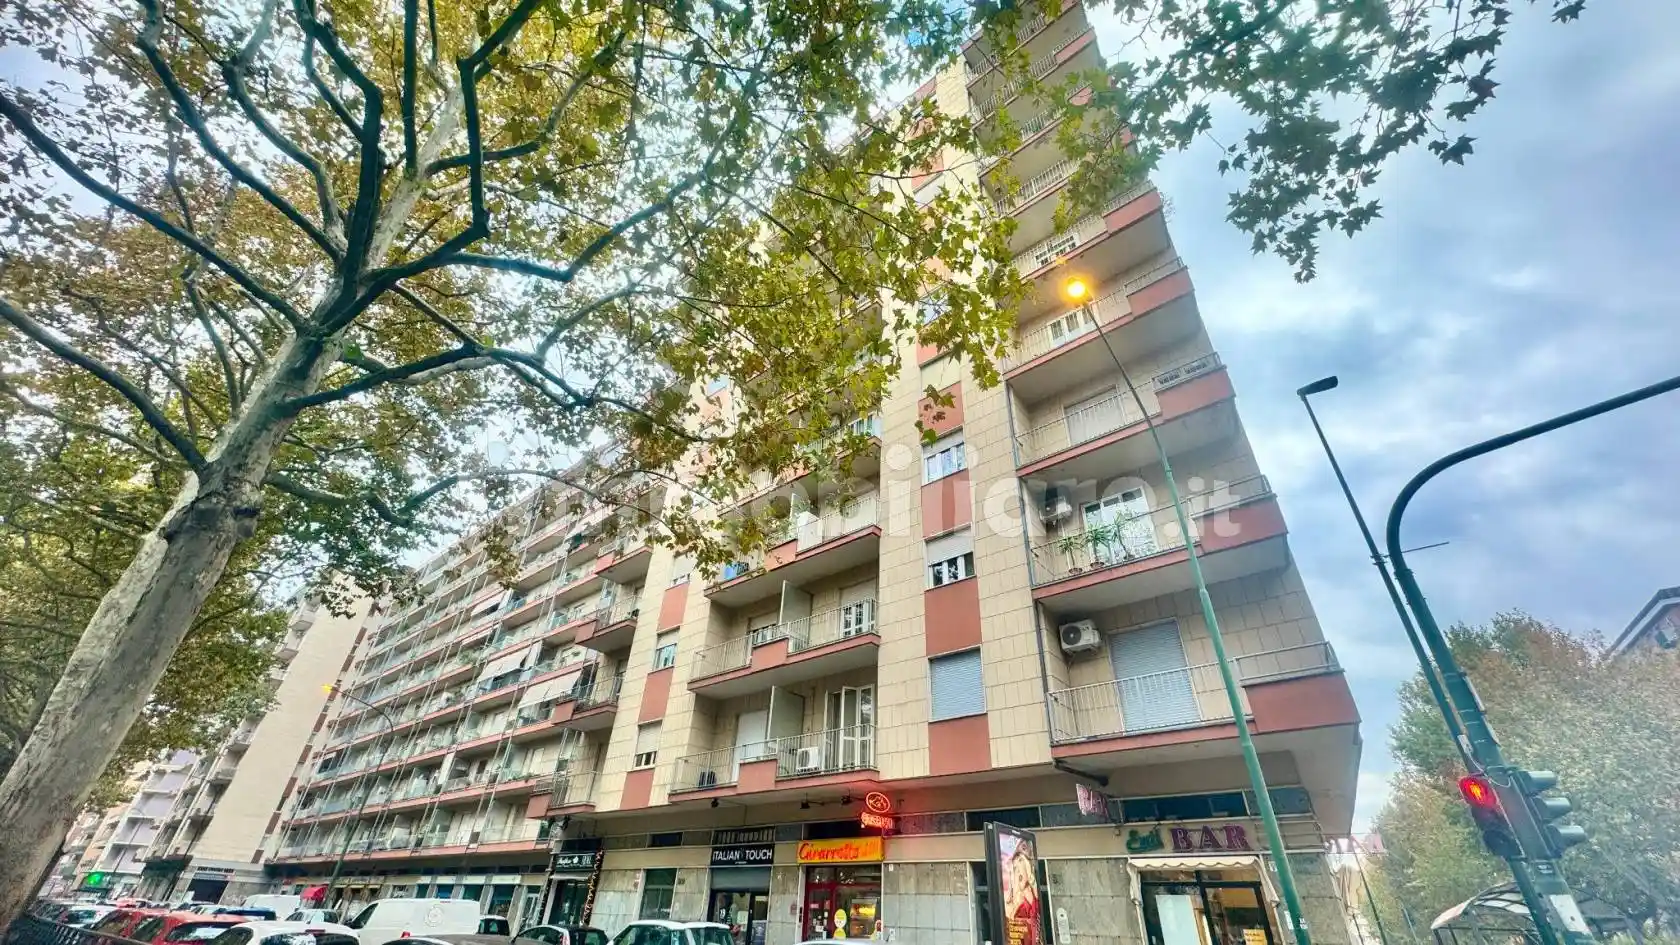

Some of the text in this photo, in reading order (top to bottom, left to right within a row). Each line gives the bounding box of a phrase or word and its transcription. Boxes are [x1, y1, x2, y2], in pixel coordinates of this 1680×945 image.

[1170, 824, 1252, 852] BAR
[712, 848, 773, 862] ITALIAN TOUCH
